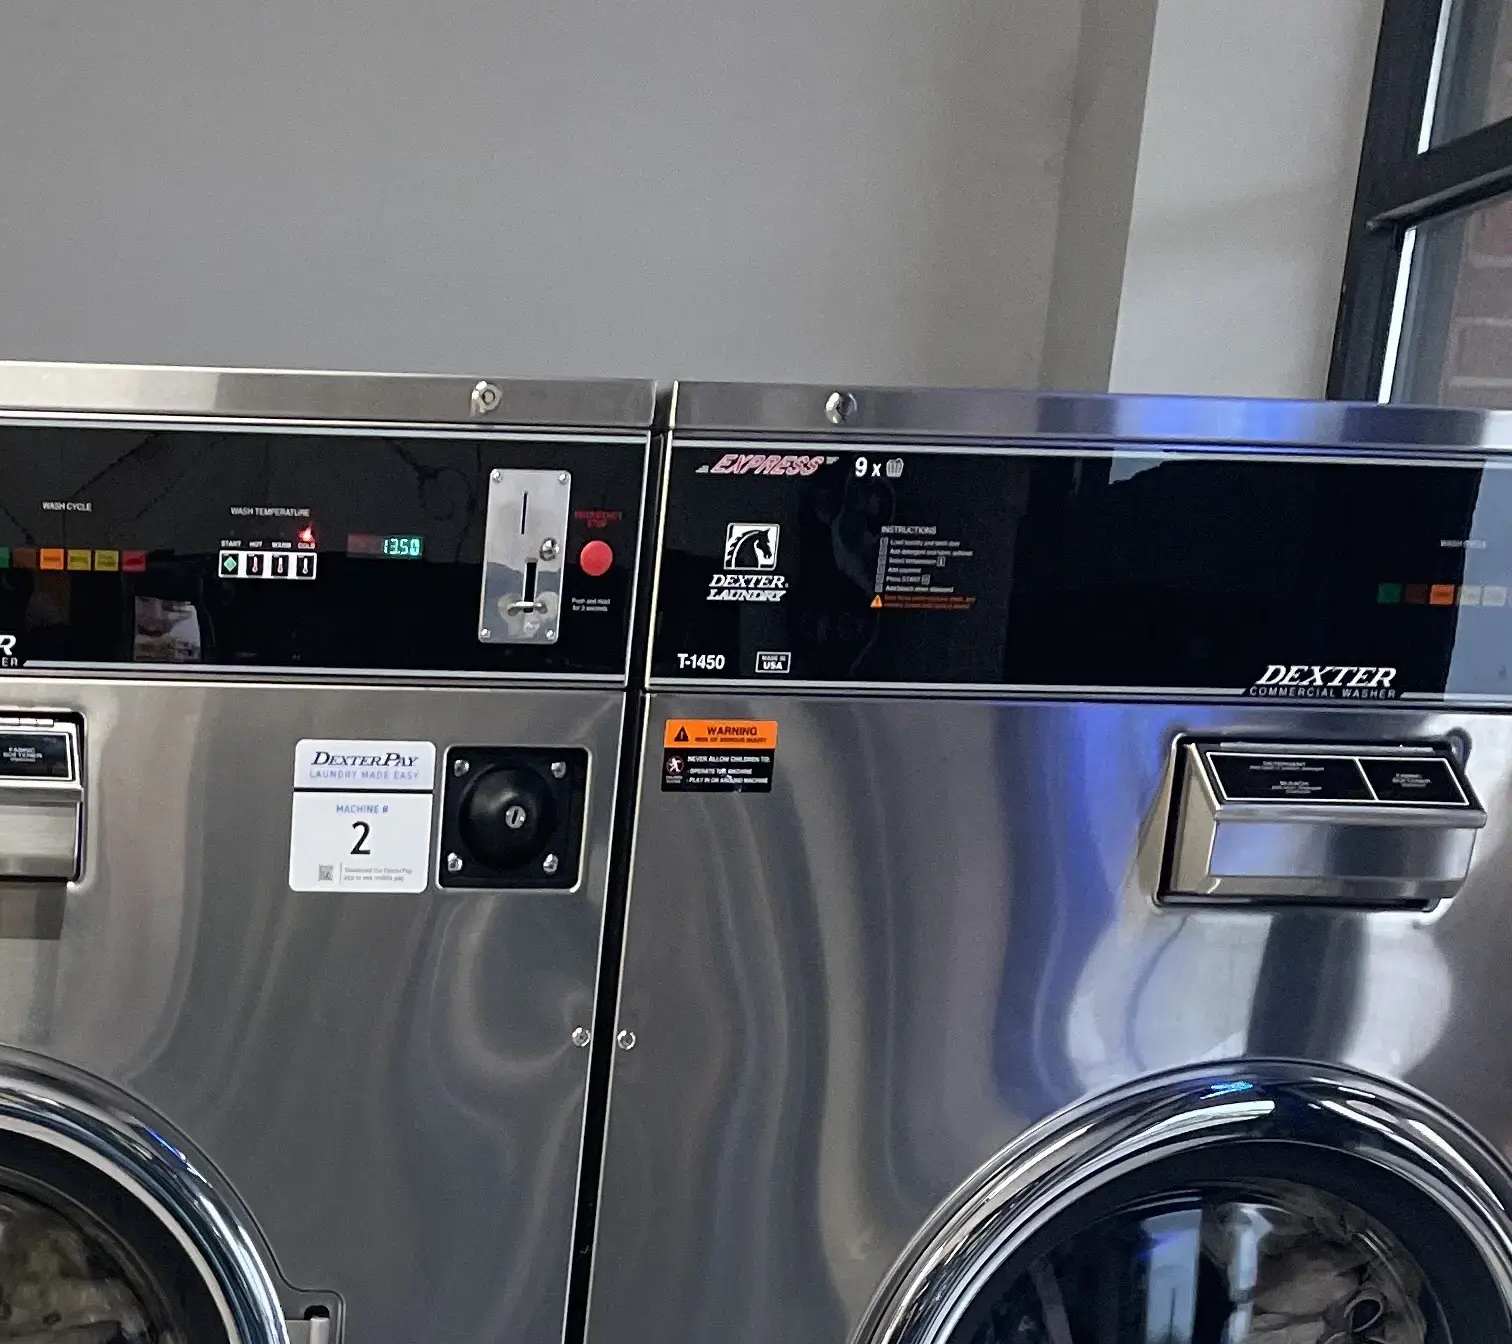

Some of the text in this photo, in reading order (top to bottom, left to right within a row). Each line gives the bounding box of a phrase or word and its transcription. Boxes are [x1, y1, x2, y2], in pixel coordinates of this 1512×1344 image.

[710, 454, 825, 476] EXPRESS
[855, 456, 868, 478] 9
[231, 507, 310, 517] WASH TEMPERATURE
[709, 574, 786, 588] DEXTER
[706, 589, 787, 602] LAUNDRY
[677, 653, 726, 670] T-1450
[763, 661, 783, 670] USA
[1254, 664, 1397, 688] DEXTER
[1249, 686, 1396, 699] COMMERCIAL WASHER
[707, 726, 757, 736] WARNING
[309, 769, 419, 780] LAUNDRY MADE EASY
[336, 804, 379, 814] MACHINE
[350, 820, 371, 855] 2
